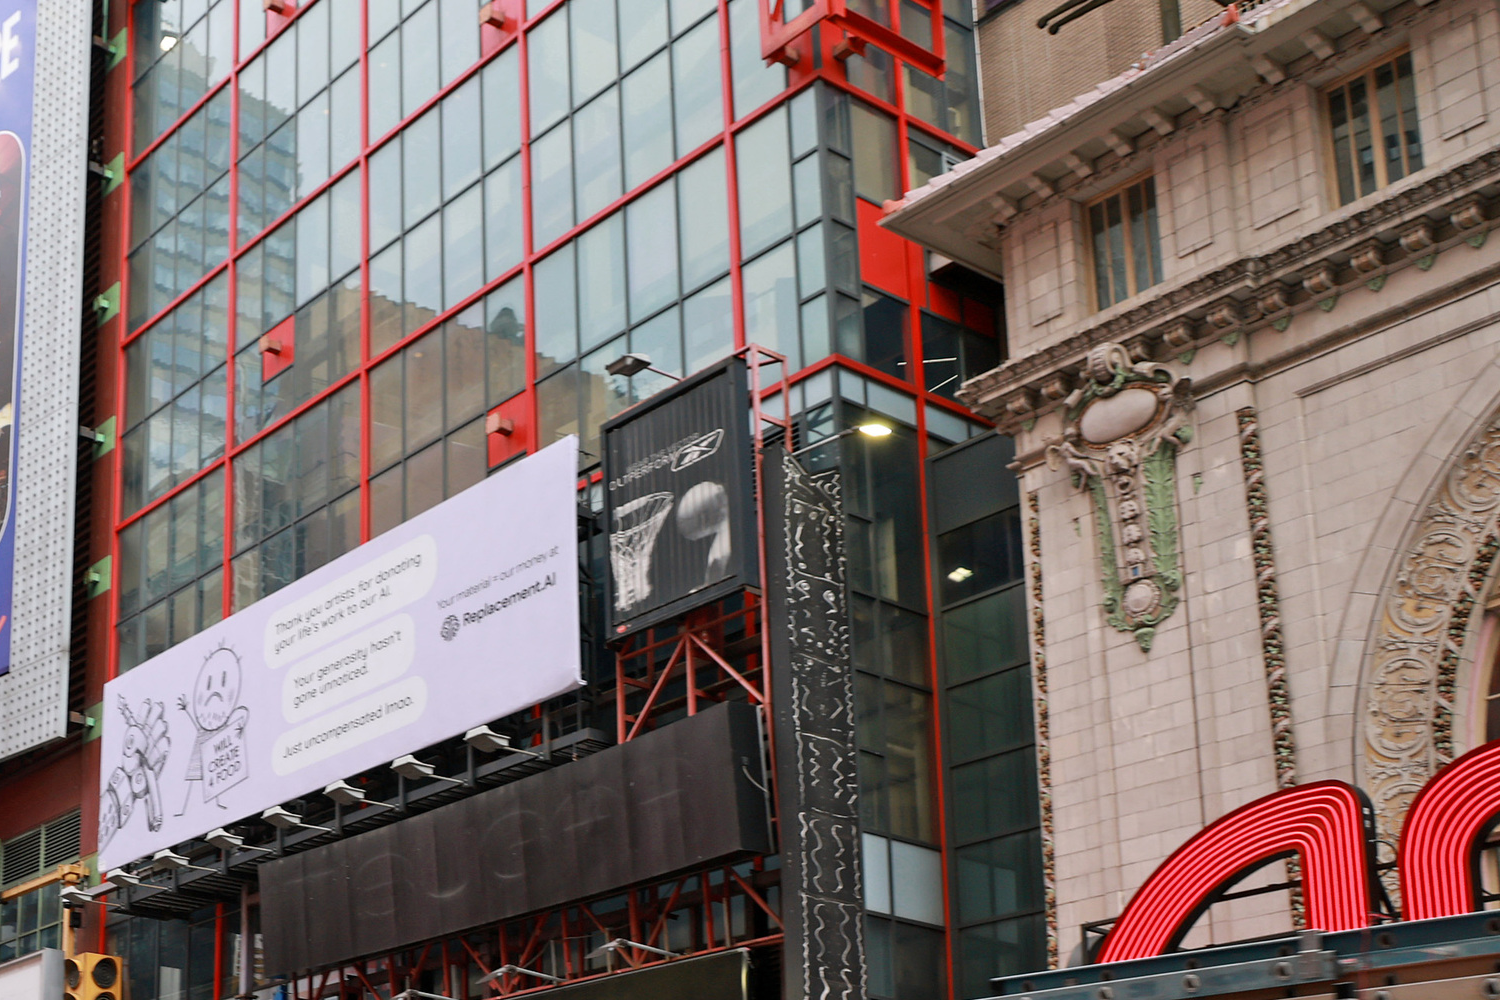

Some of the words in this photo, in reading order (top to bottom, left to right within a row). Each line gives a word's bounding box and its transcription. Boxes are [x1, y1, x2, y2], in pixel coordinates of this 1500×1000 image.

[275, 613, 303, 635] Thank
[305, 605, 323, 623] you
[324, 588, 355, 611] artists
[358, 579, 373, 593] for
[375, 554, 421, 585] donating
[436, 596, 455, 610] Your
[456, 576, 490, 602] material
[500, 567, 514, 581] our
[516, 552, 547, 574] money
[548, 545, 559, 557] at
[463, 572, 556, 627] Replacement.AI
[275, 634, 296, 655] your
[298, 621, 319, 640] life's
[322, 608, 345, 628] work
[347, 604, 357, 615] to
[360, 594, 377, 609] our
[294, 672, 315, 688] Your
[317, 647, 368, 682] generosity
[370, 630, 401, 653] hasn't
[294, 688, 317, 708] gone
[319, 662, 368, 694] unnoticed.
[213, 735, 232, 754] WILL
[283, 741, 302, 759] Just
[304, 705, 383, 749] uncompensated
[385, 696, 414, 715] lmao.
[208, 745, 239, 773] CREATE
[216, 760, 242, 784] FOOD
